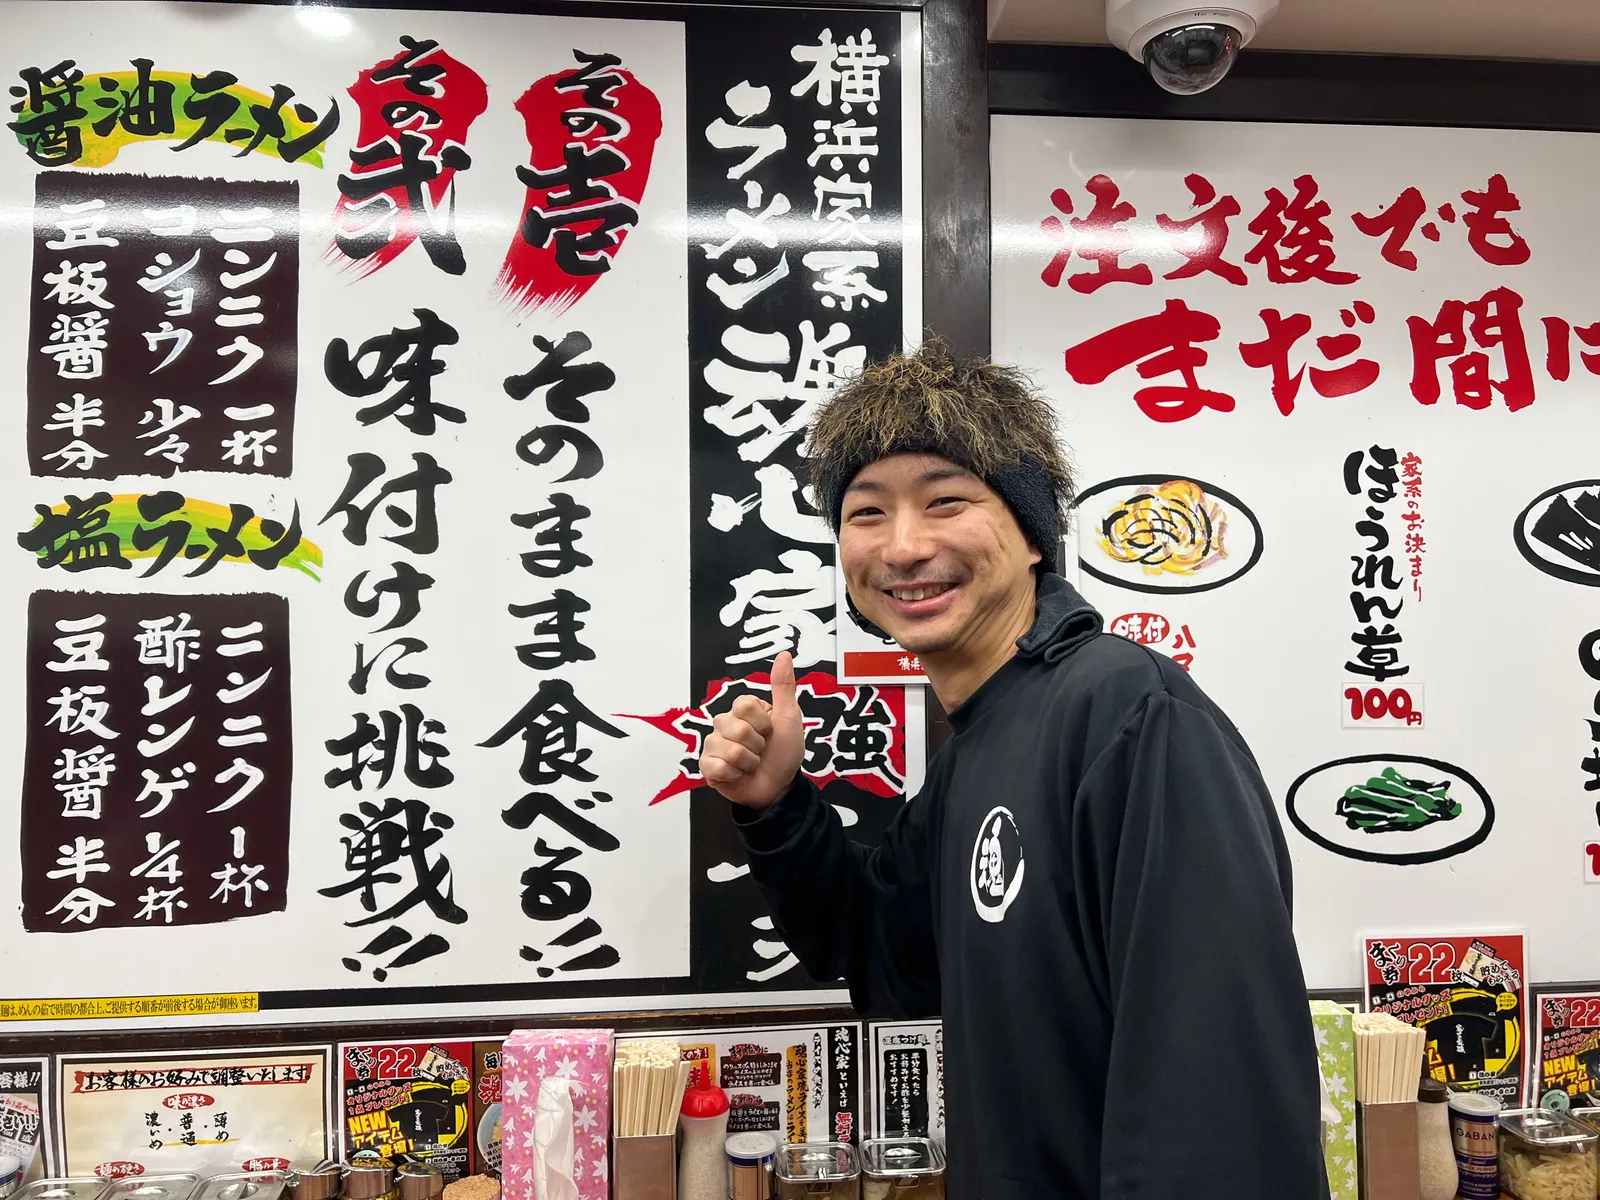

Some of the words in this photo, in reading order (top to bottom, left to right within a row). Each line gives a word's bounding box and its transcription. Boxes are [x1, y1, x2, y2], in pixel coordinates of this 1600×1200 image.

[8, 58, 341, 167] 醤油ラーメン
[516, 48, 638, 276] その壱
[700, 80, 791, 310] ラーメン
[790, 28, 890, 311] 横浜家系
[1040, 174, 1530, 294] 注文後でも
[41, 200, 118, 379] 豆板醤
[137, 205, 200, 374] コショウ
[208, 207, 277, 385] ニンニク
[42, 394, 108, 470] 半分
[138, 398, 200, 467] 少々
[222, 404, 277, 467] 一杯
[17, 491, 302, 578] 塩ラーメン
[1344, 445, 1410, 682] ほうれん草
[1401, 452, 1427, 603] 家系のお決まり
[1113, 614, 1165, 642] 味付
[45, 614, 120, 820] 豆板醤
[136, 613, 200, 819] 酢レンゲ
[207, 621, 272, 815] ニンニク
[1344, 687, 1422, 726] 100円
[45, 836, 115, 924] 半分
[1544, 1054, 1576, 1077] NEW
[145, 1112, 162, 1150] 濃いめ
[180, 1112, 197, 1146] 普通
[348, 1110, 387, 1134] NEW
[352, 1128, 403, 1149] アイテム
[1456, 1128, 1495, 1140] GABAN
